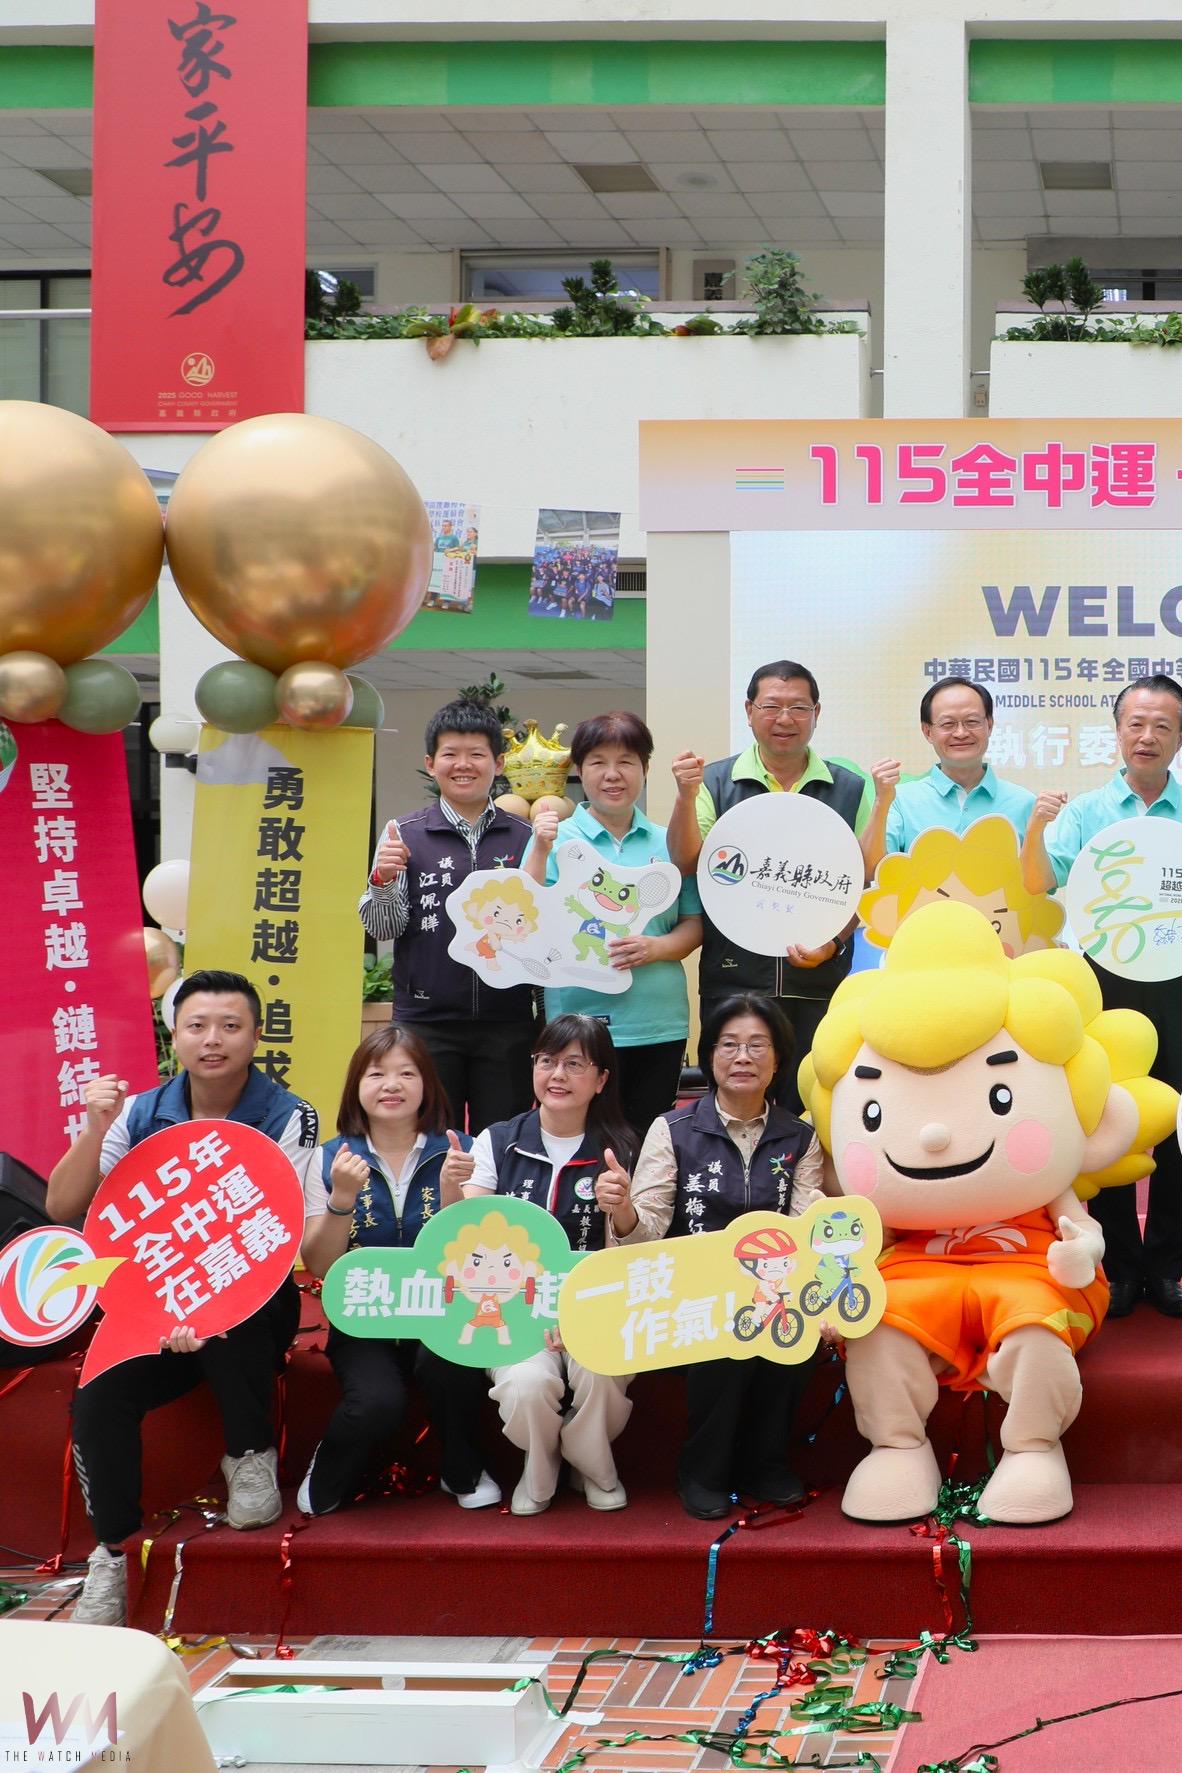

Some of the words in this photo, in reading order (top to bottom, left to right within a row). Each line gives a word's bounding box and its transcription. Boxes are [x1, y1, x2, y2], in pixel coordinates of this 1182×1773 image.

[995, 694, 1046, 708] MIDDLE
[1049, 694, 1097, 708] SCHOOL
[750, 856, 852, 894] 嘉義縣政府
[751, 880, 774, 891] Chiayi
[776, 885, 802, 898] County
[803, 891, 847, 906] Government
[98, 1130, 232, 1242] 115年
[707, 1160, 723, 1192] 議員
[132, 1163, 265, 1281] 全中運
[155, 1207, 292, 1322] 在嘉義
[575, 1252, 676, 1308] 一鼓
[342, 1267, 446, 1318] 熱血
